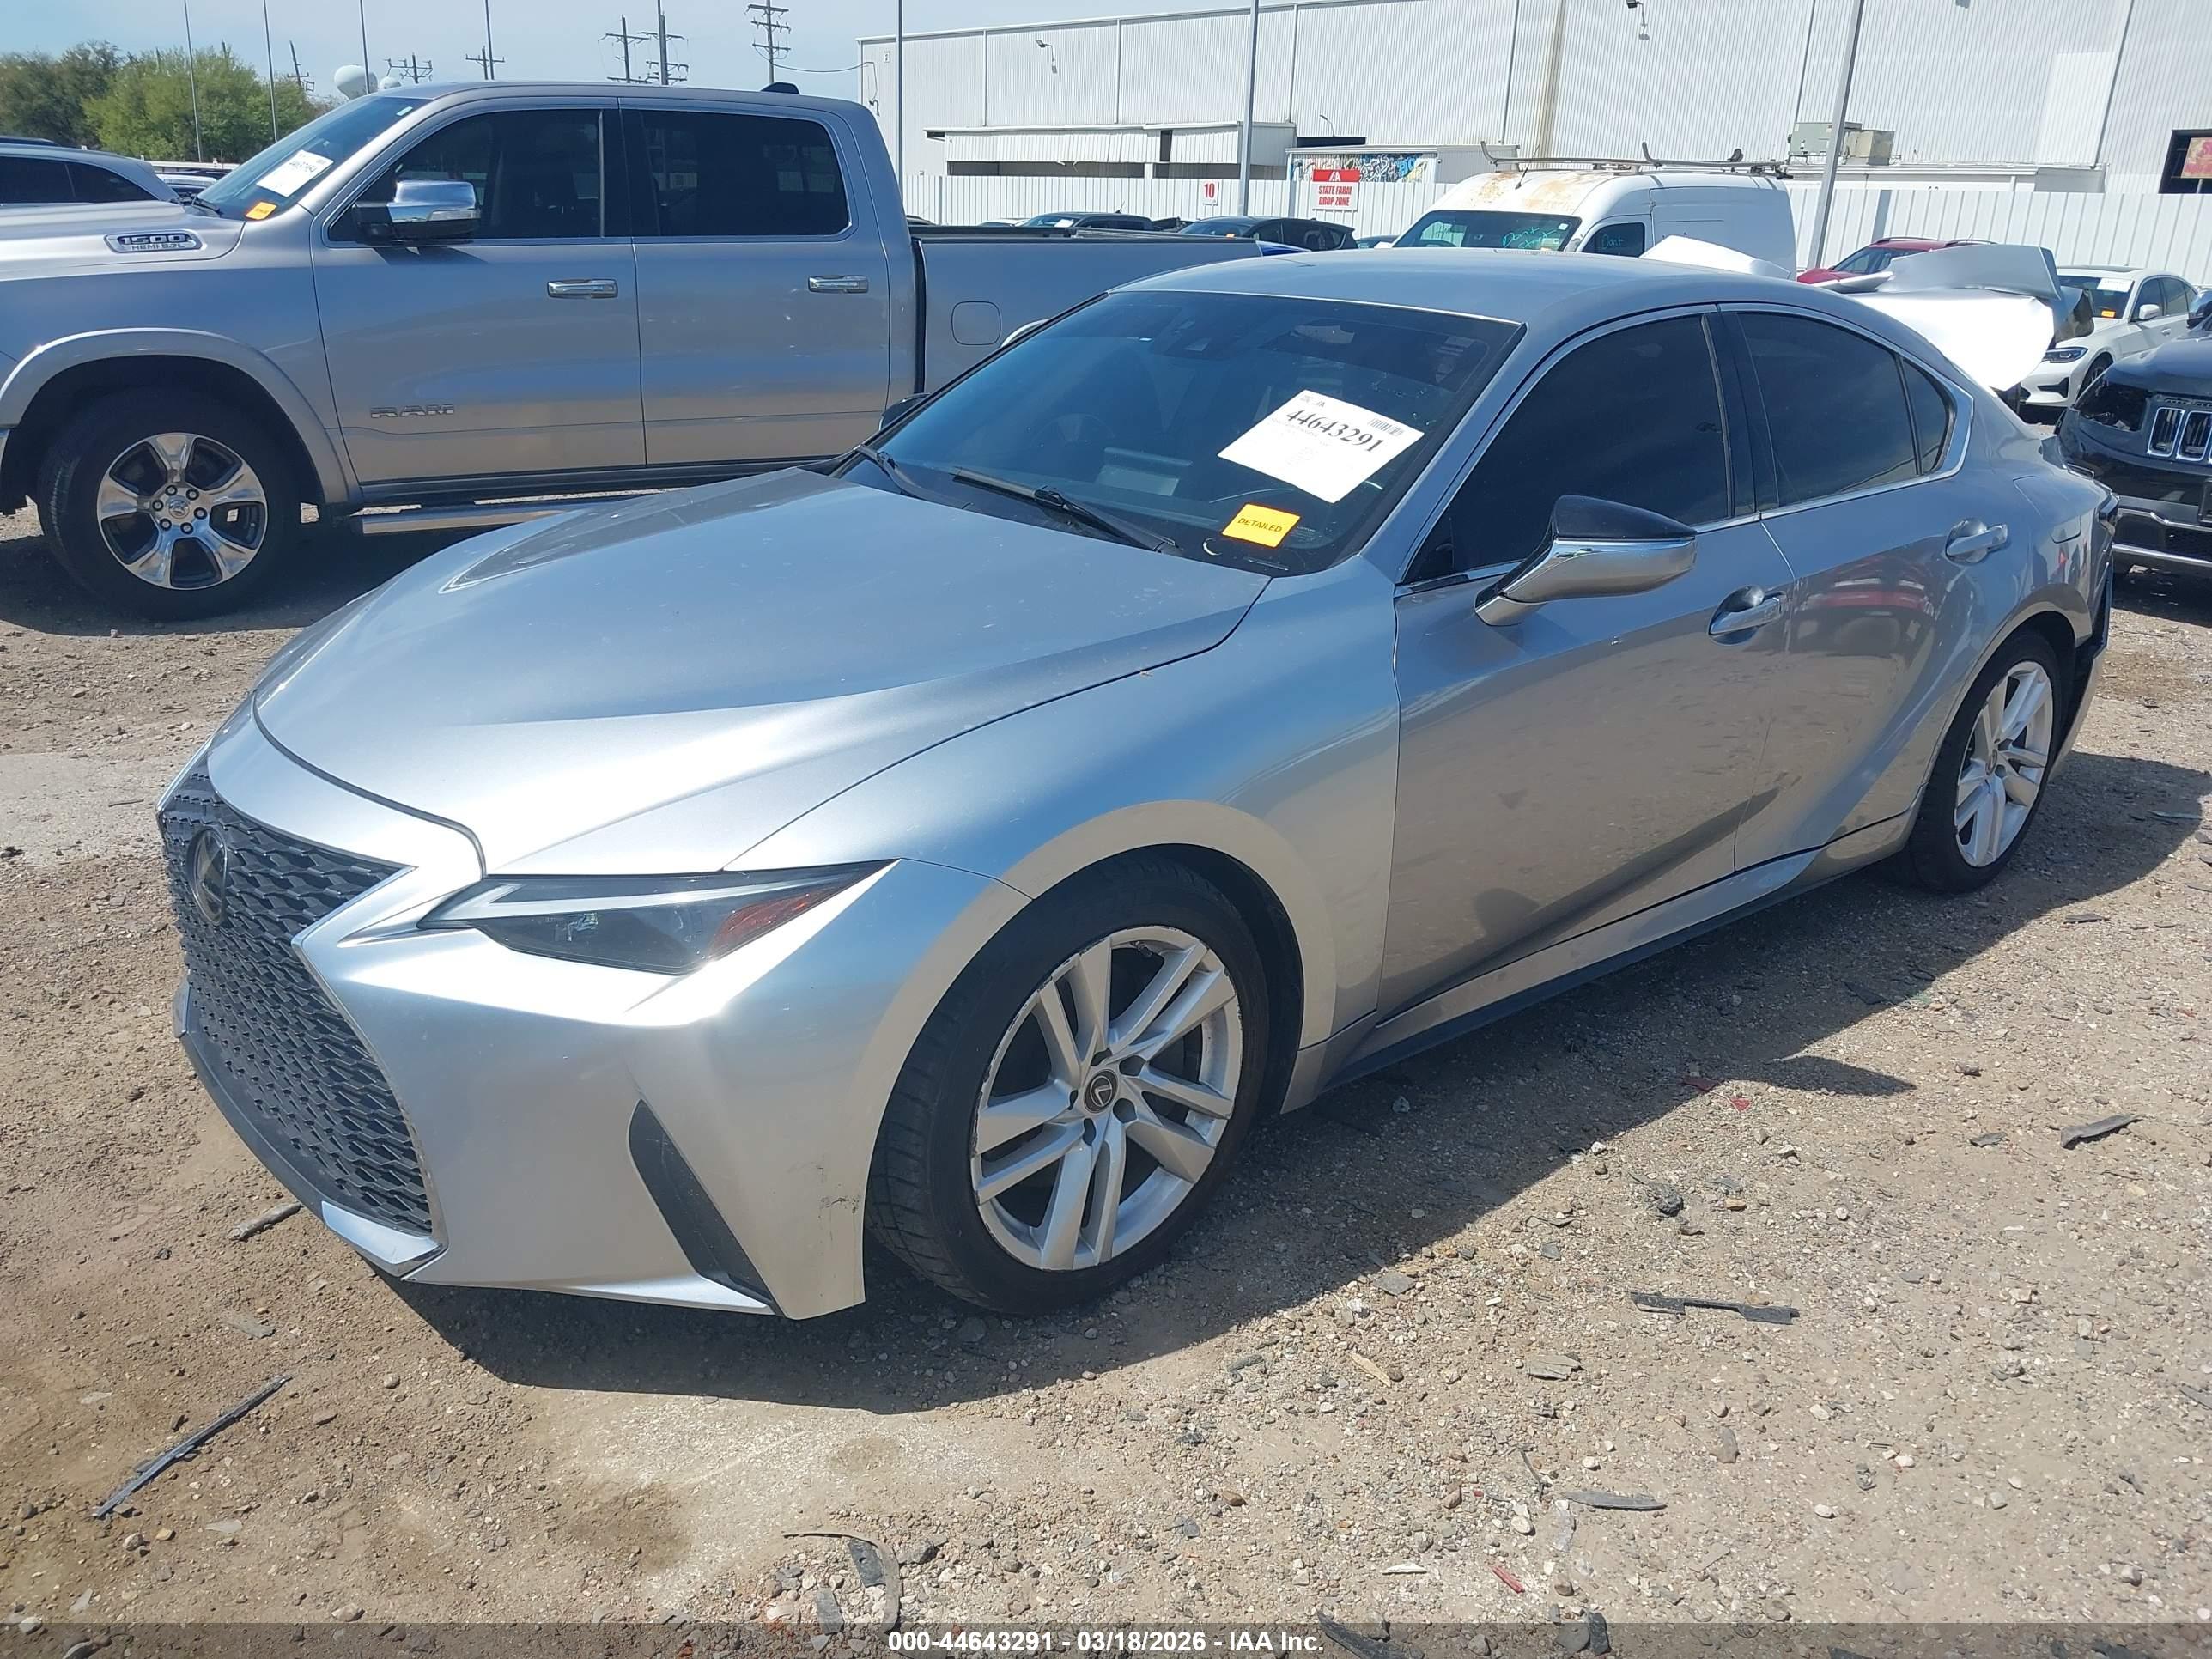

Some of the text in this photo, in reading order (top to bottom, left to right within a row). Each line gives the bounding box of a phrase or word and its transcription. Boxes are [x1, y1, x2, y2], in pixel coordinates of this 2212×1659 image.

[1204, 183, 1215, 198] 10
[1318, 185, 1353, 195] STATE FARM
[1318, 197, 1351, 206] DROP ZONE
[120, 234, 187, 245] 1500
[370, 404, 454, 419] RAM
[1285, 409, 1384, 453] 44643291
[1237, 517, 1283, 533] DETAILED
